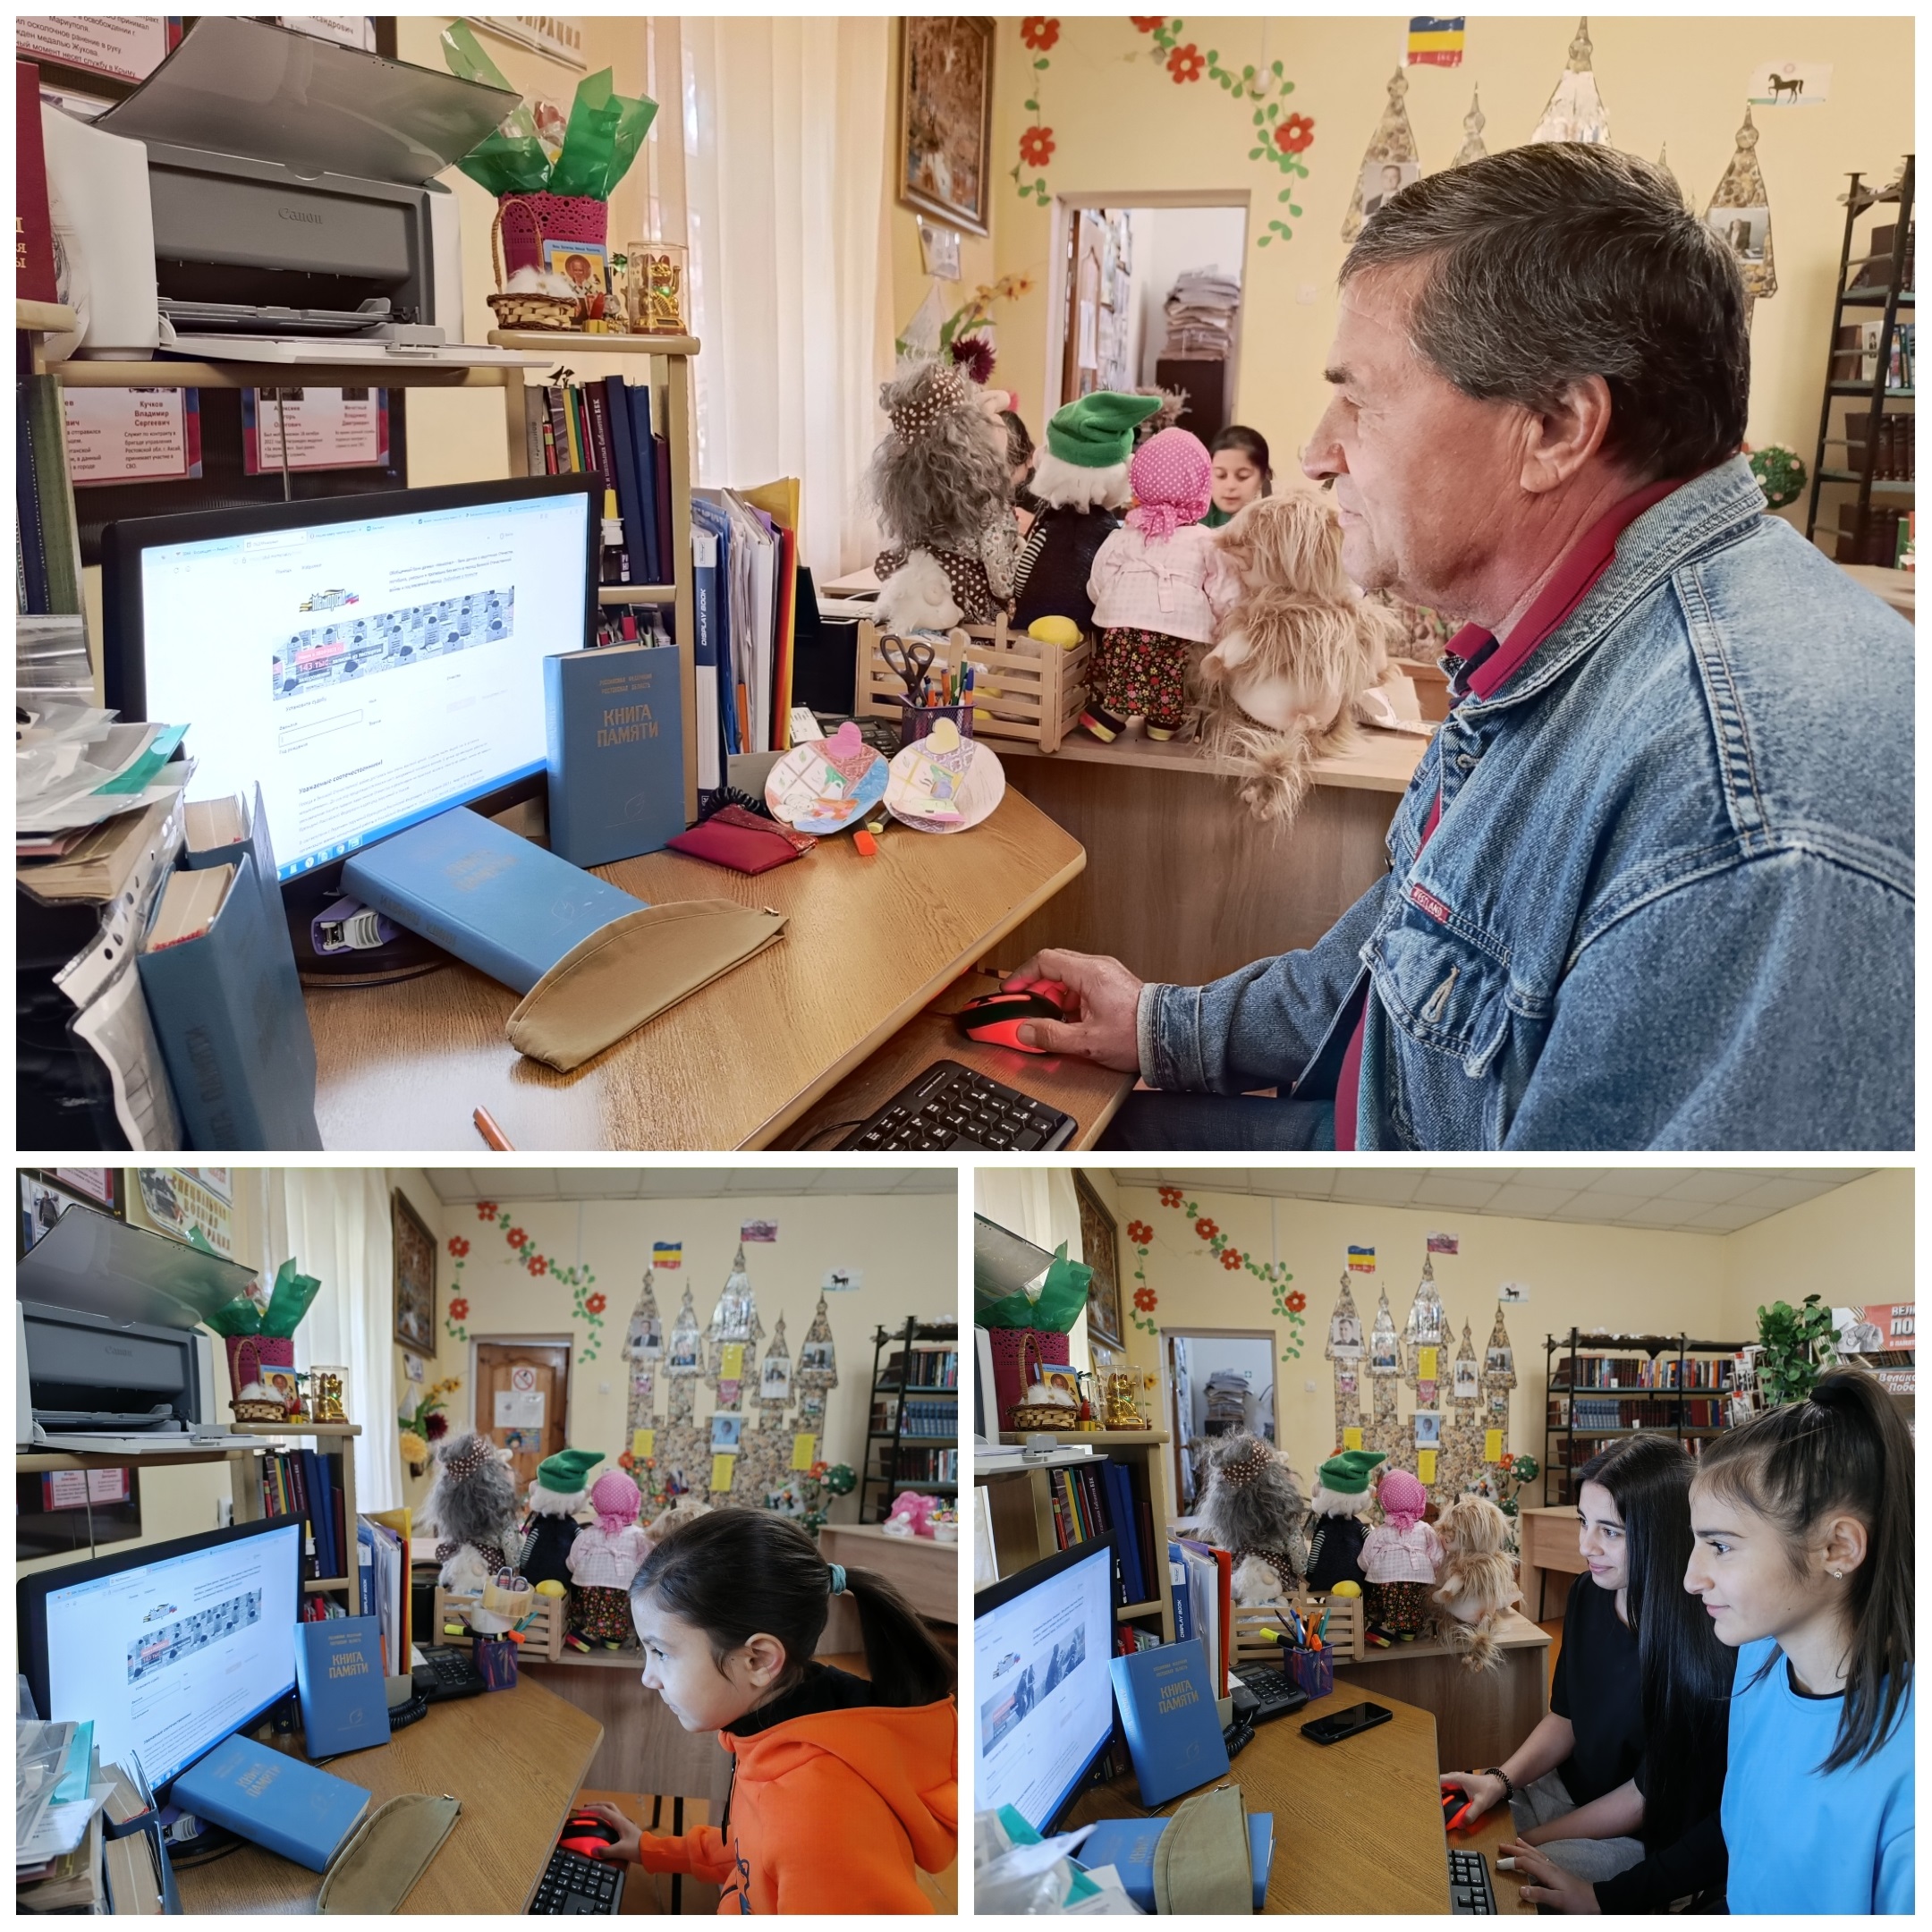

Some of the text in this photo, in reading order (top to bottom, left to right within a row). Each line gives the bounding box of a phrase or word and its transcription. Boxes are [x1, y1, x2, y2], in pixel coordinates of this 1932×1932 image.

[27, 21, 70, 38] осколочное
[72, 33, 99, 47] ранение
[37, 35, 71, 49] медалью
[32, 45, 61, 56] момент
[134, 410, 170, 419] Владимир
[134, 419, 170, 428] Сергеевич
[603, 703, 653, 727] КНИГА
[597, 720, 659, 748] ПАМЯТИ
[332, 1650, 364, 1666] КНИГА
[328, 1662, 369, 1679] ПАМЯТИ
[1160, 1679, 1193, 1699] КНИГА
[1158, 1690, 1199, 1715] ПАМЯТИ
